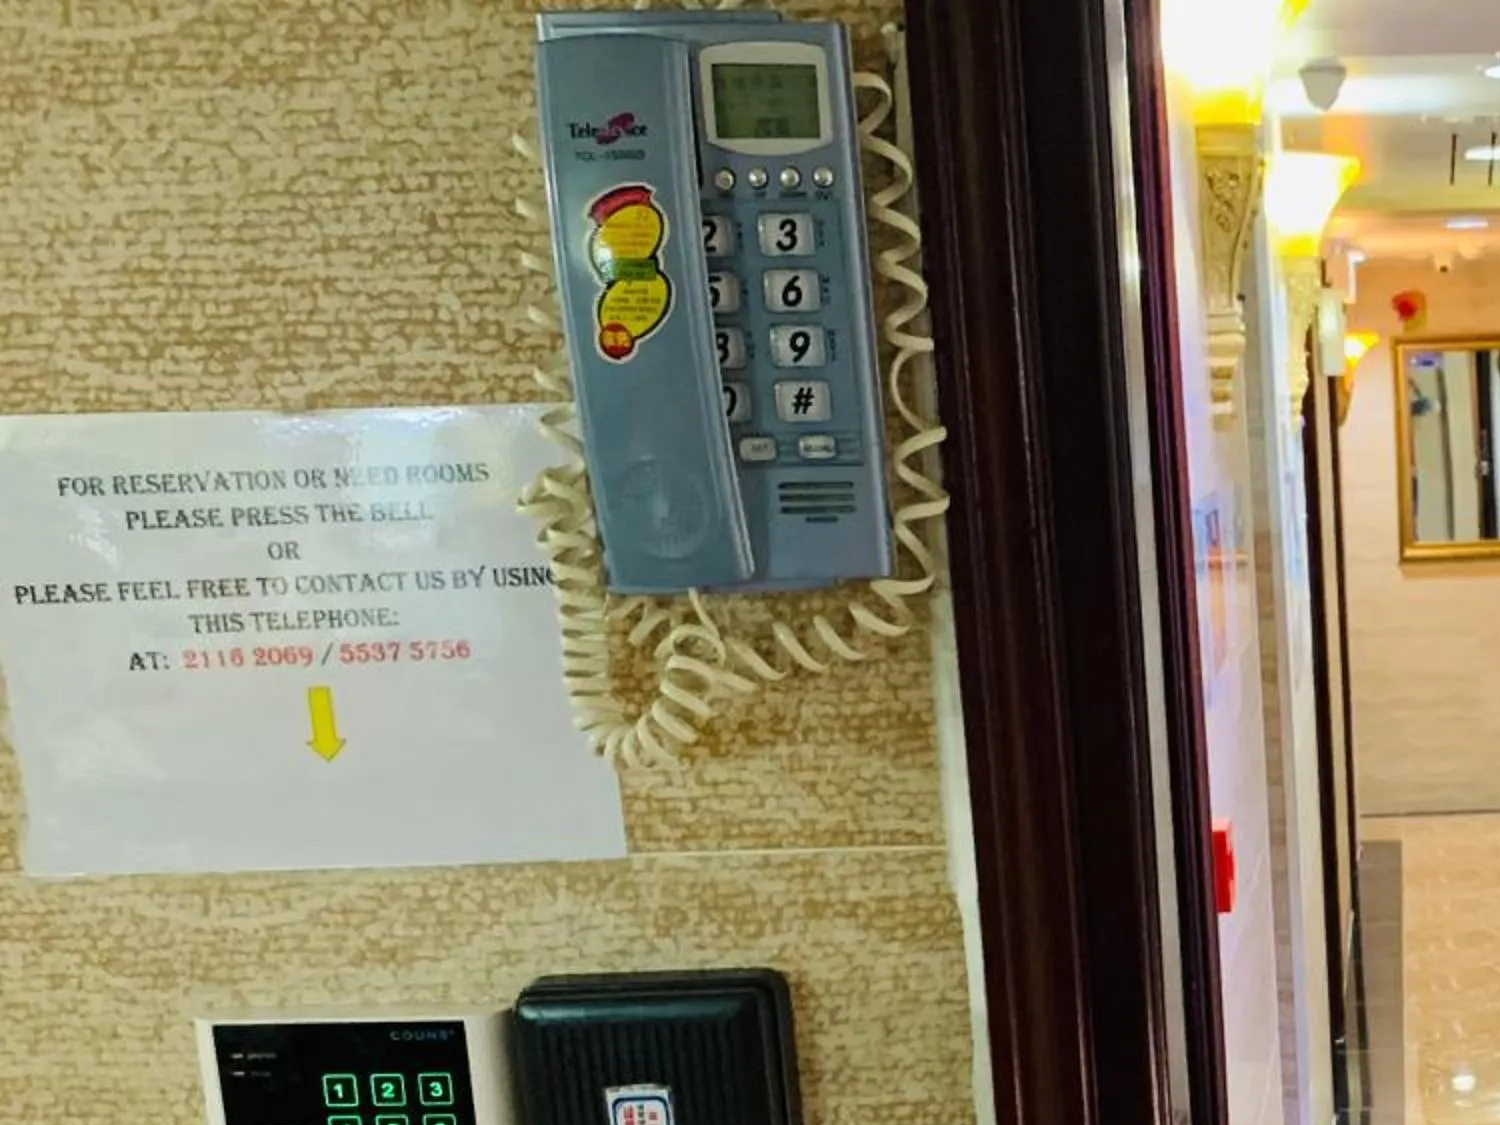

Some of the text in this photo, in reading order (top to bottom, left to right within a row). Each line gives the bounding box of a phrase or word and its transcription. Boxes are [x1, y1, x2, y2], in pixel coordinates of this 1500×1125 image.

[702, 220, 717, 253] 2
[776, 218, 798, 251] 3
[782, 275, 803, 307] 6
[789, 331, 811, 363] 9
[792, 387, 815, 415] #
[57, 476, 105, 497] FOR
[112, 469, 287, 495] RESERVATION
[294, 468, 327, 489] OR
[406, 462, 490, 487] ROOMS
[125, 500, 435, 531] PLEASE PRESS THE BELL
[267, 540, 301, 562] OR
[14, 583, 112, 606] PLEASE
[117, 580, 181, 601] FEEL
[187, 577, 250, 598] FREE
[255, 576, 288, 596] TO
[294, 571, 409, 595] CONTACT
[415, 570, 446, 591] US
[452, 564, 487, 590] BY
[188, 607, 401, 635] THIS TELEPHONE:
[129, 650, 171, 671] AT:
[182, 646, 245, 670] 2116
[253, 646, 314, 668] 2069
[338, 639, 401, 664] 5537
[409, 637, 472, 661] 5756
[333, 1081, 443, 1099] 1 2 3
